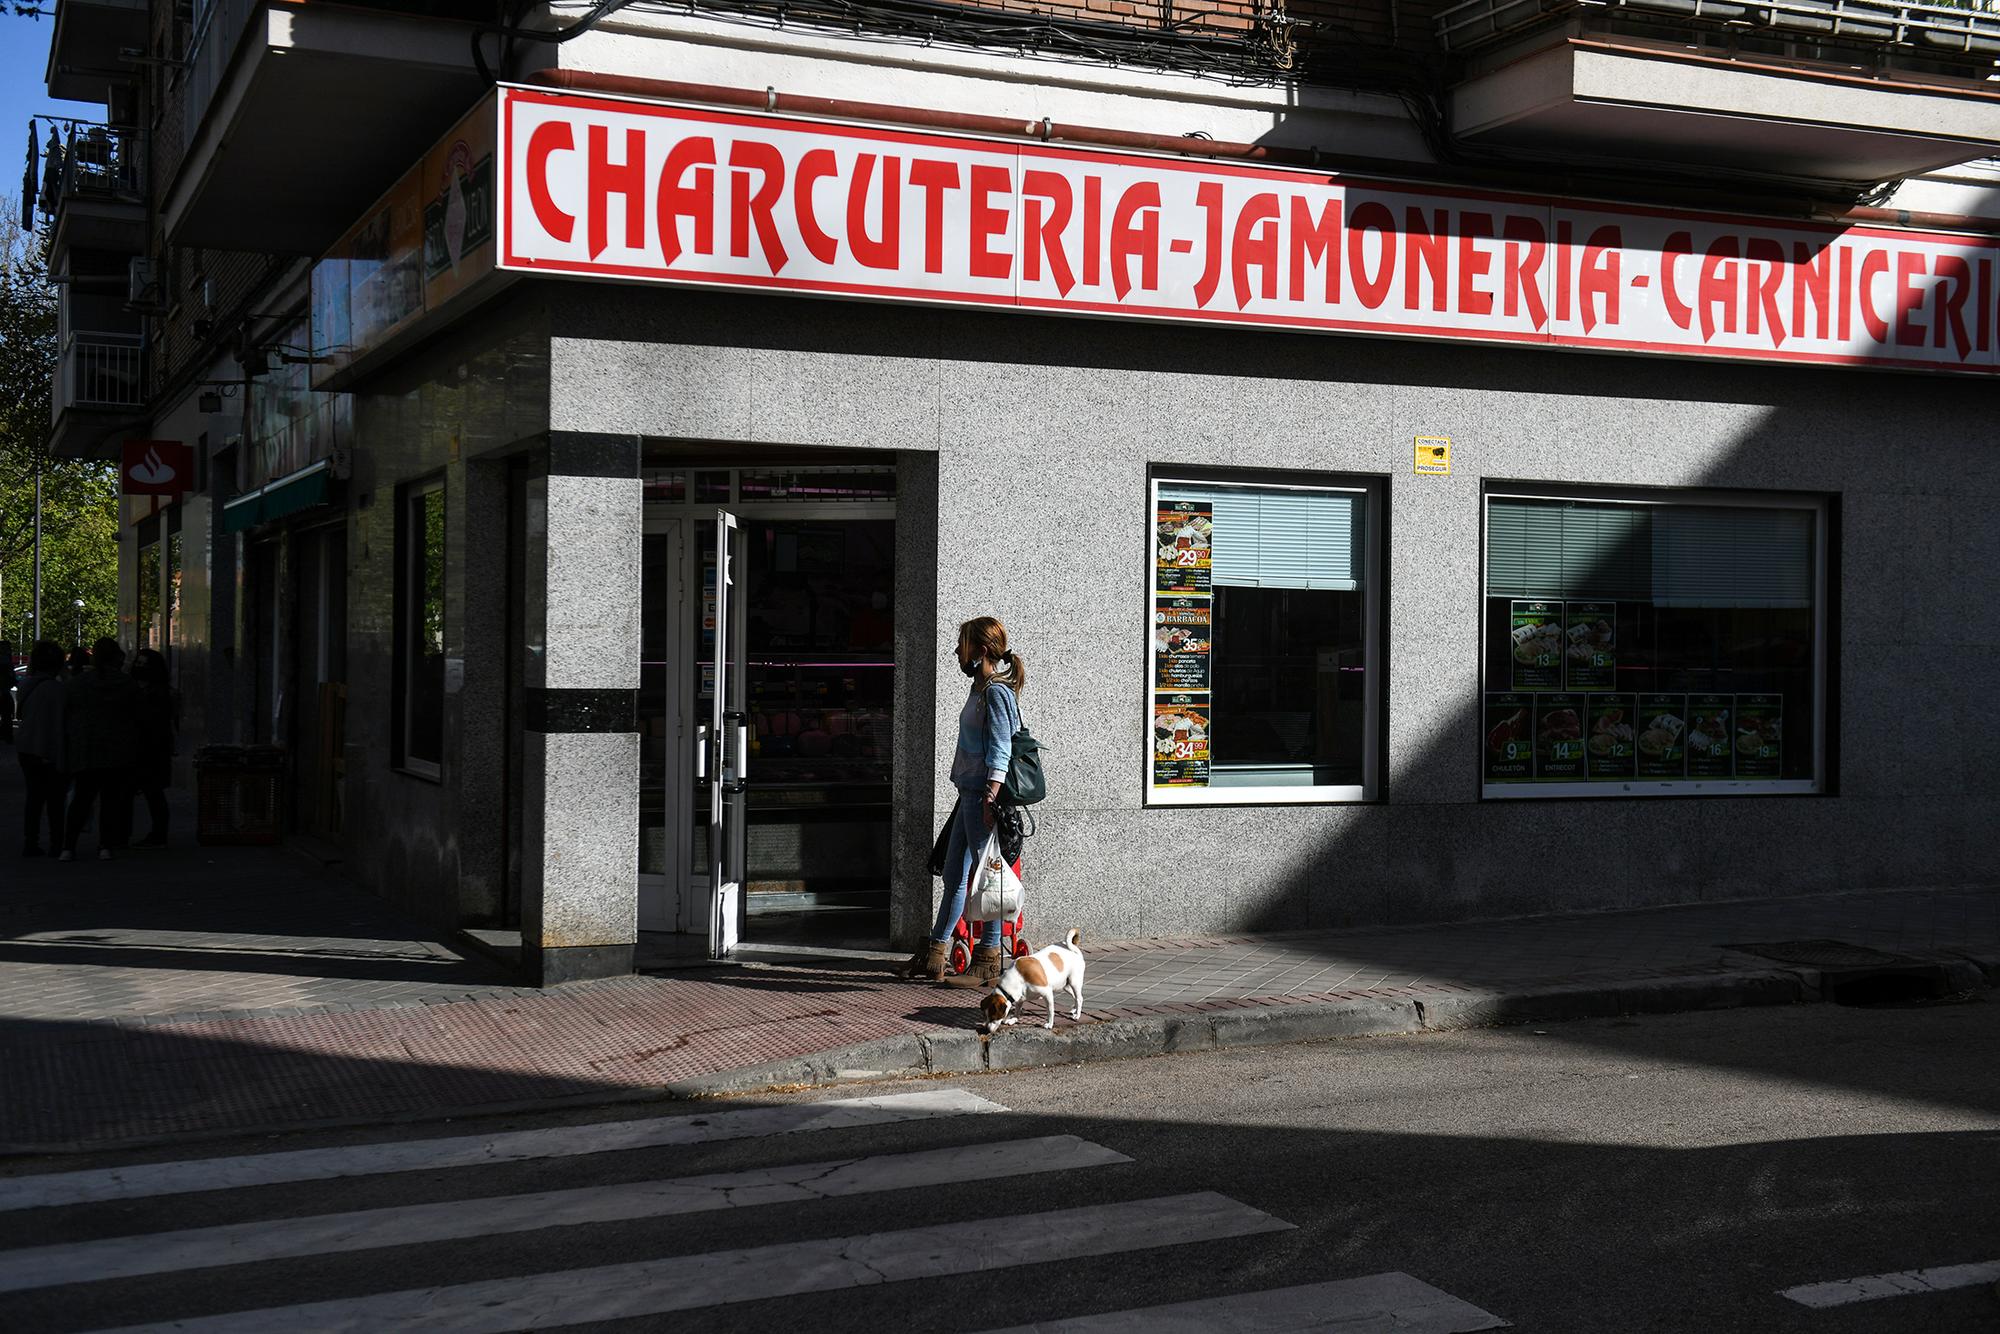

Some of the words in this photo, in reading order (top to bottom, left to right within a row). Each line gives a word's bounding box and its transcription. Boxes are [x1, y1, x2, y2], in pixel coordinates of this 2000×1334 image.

[1167, 615, 1207, 625] BARBACOA
[1537, 655, 1550, 666] 13
[1592, 655, 1604, 666] 15
[1175, 742, 1194, 758] 34
[1506, 743, 1517, 760] 9
[1553, 742, 1570, 760] 14
[1612, 745, 1624, 757] 12
[1664, 747, 1672, 759] 7
[1710, 744, 1722, 756] 16
[1759, 746, 1769, 757] 19
